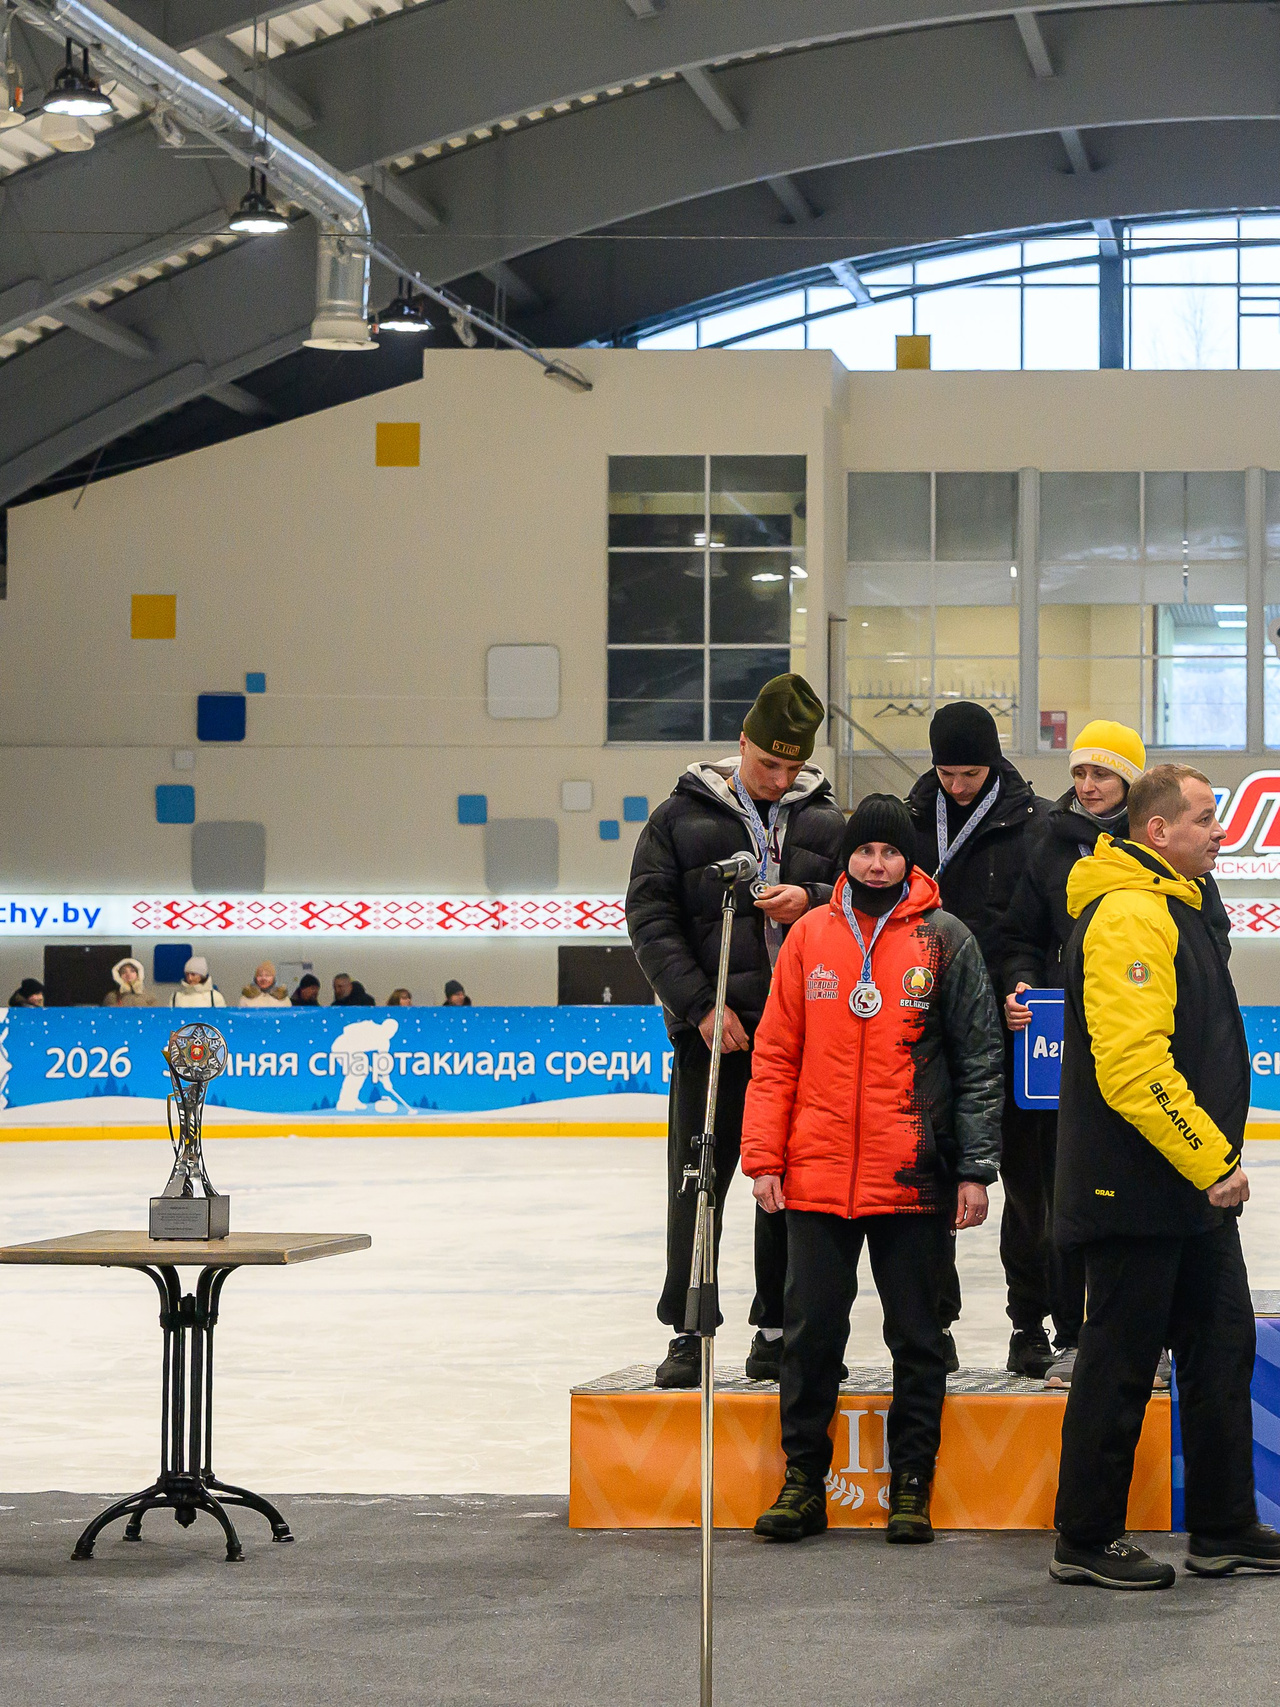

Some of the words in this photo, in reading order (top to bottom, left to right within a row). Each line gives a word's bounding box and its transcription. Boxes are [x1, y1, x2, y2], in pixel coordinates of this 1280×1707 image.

[45, 1046, 132, 1079] 2026
[308, 1050, 537, 1083] спартакиада
[545, 1050, 652, 1083] среди
[1032, 1035, 1065, 1064] Аг
[1149, 1082, 1204, 1151] BELARUS
